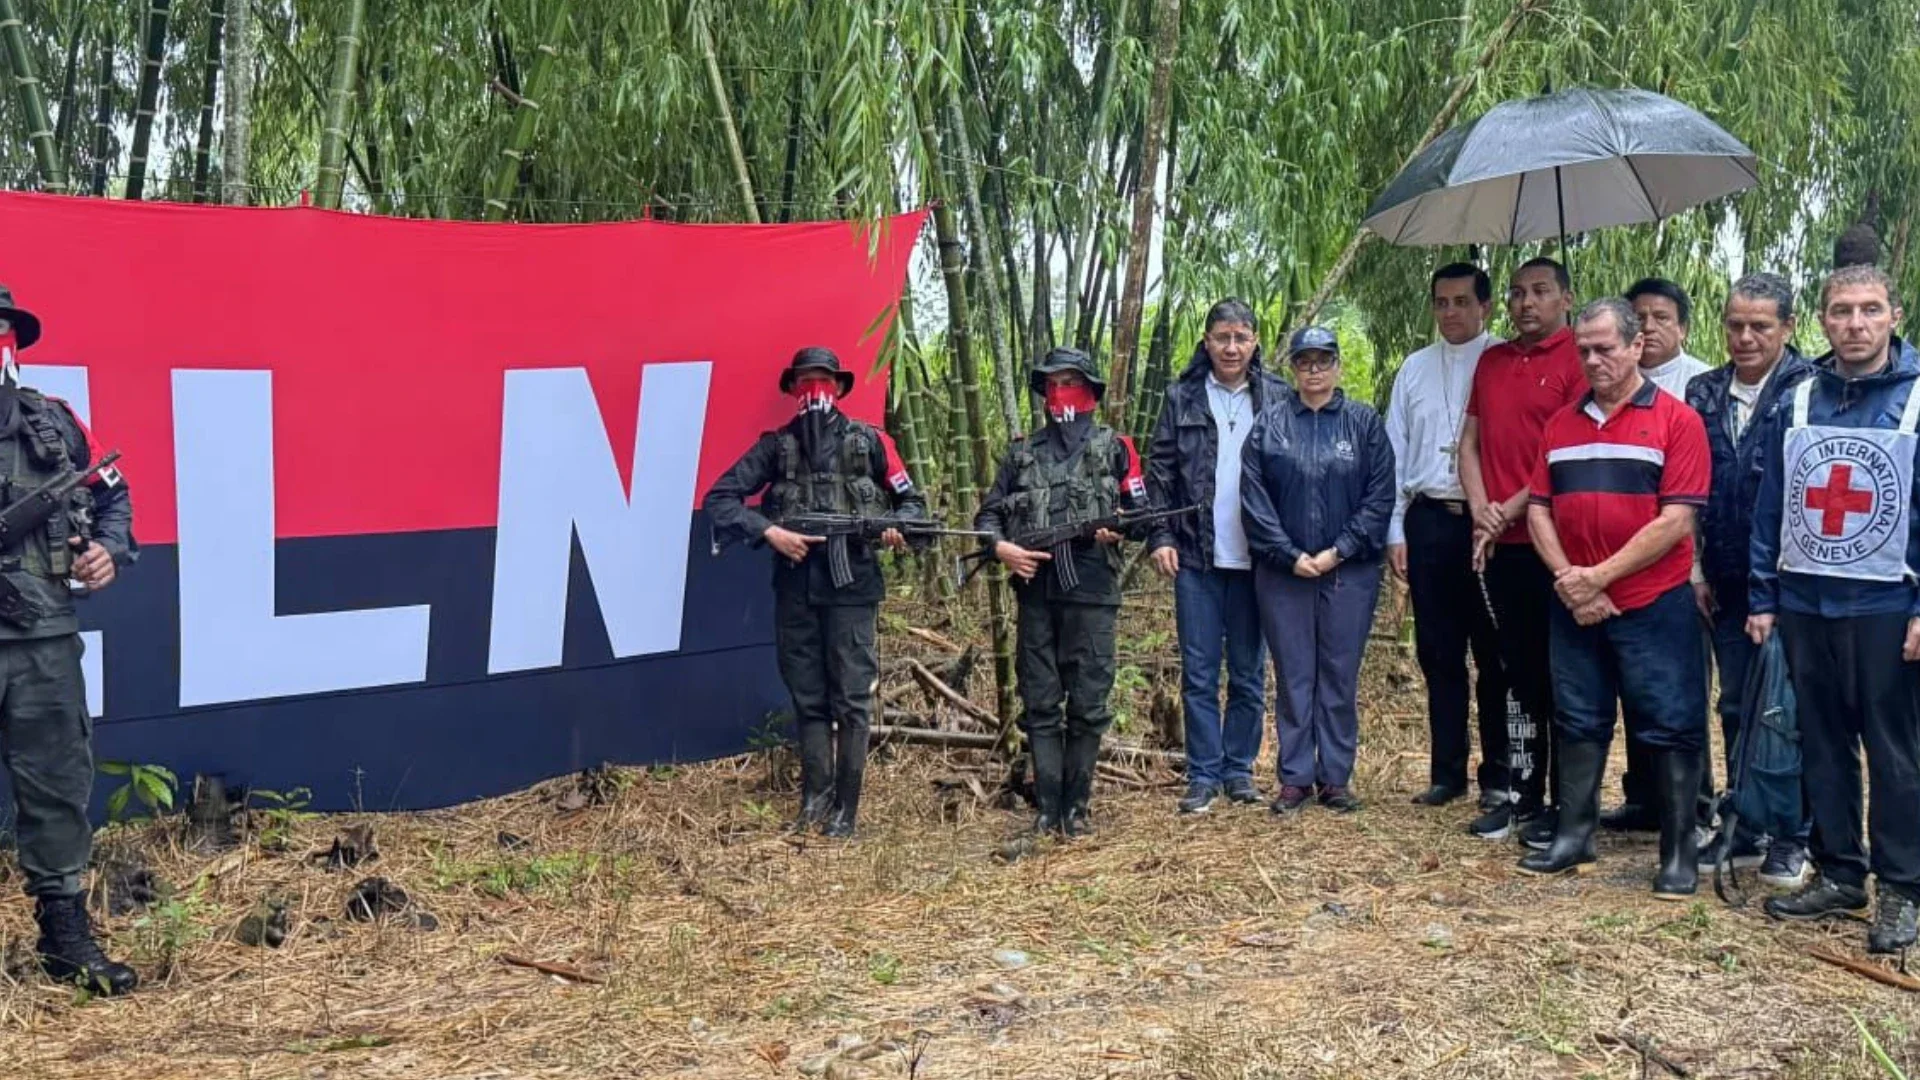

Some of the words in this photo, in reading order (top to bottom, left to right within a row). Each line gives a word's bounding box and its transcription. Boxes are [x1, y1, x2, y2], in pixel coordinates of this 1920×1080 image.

[1789, 456, 1812, 528] COMITE
[1818, 441, 1897, 535] INTERNATIONAL
[19, 361, 713, 718] LN
[1801, 534, 1866, 560] GENEVE
